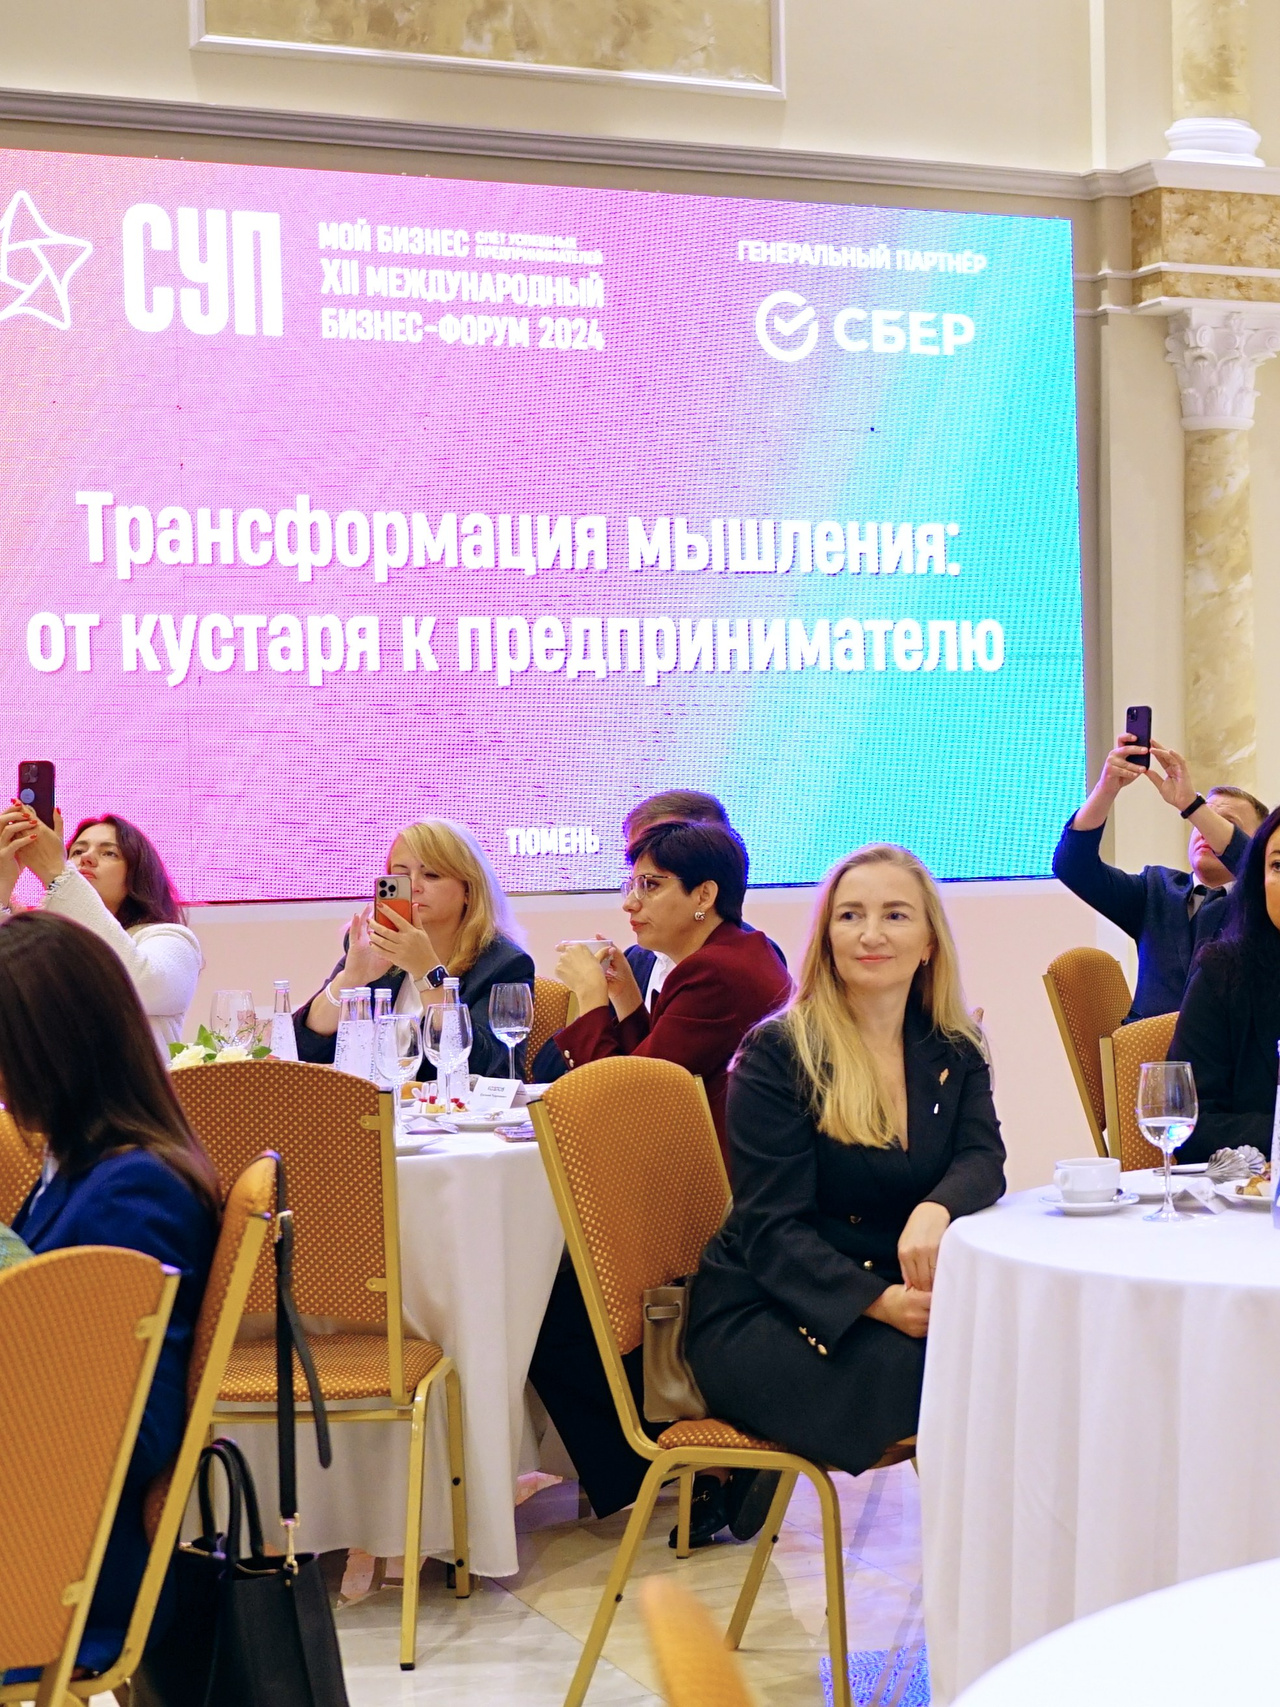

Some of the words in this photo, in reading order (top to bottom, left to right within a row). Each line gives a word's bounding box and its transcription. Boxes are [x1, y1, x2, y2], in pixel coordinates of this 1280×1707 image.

[318, 218, 371, 253] МОЙ
[377, 227, 470, 258] БИЗНЕС
[738, 240, 891, 271] ГЕНЕРАЛЬНЫЙ
[896, 249, 987, 275] ПАРТНЁР
[122, 203, 284, 337] СУП
[366, 266, 605, 308] МЕЖДУНАРОДНЫЙ
[321, 307, 530, 348] БИЗНЕС-ФОРУМ
[538, 316, 605, 351] 2024
[833, 308, 975, 356] СБЕР
[75, 490, 608, 582] Трансформация
[628, 513, 962, 576] мышления:
[26, 611, 101, 672] от
[121, 613, 381, 686] кустаря
[402, 615, 440, 672] к
[457, 615, 1006, 686] предпринимателю
[506, 827, 600, 856] ТЮМЕНЬ
